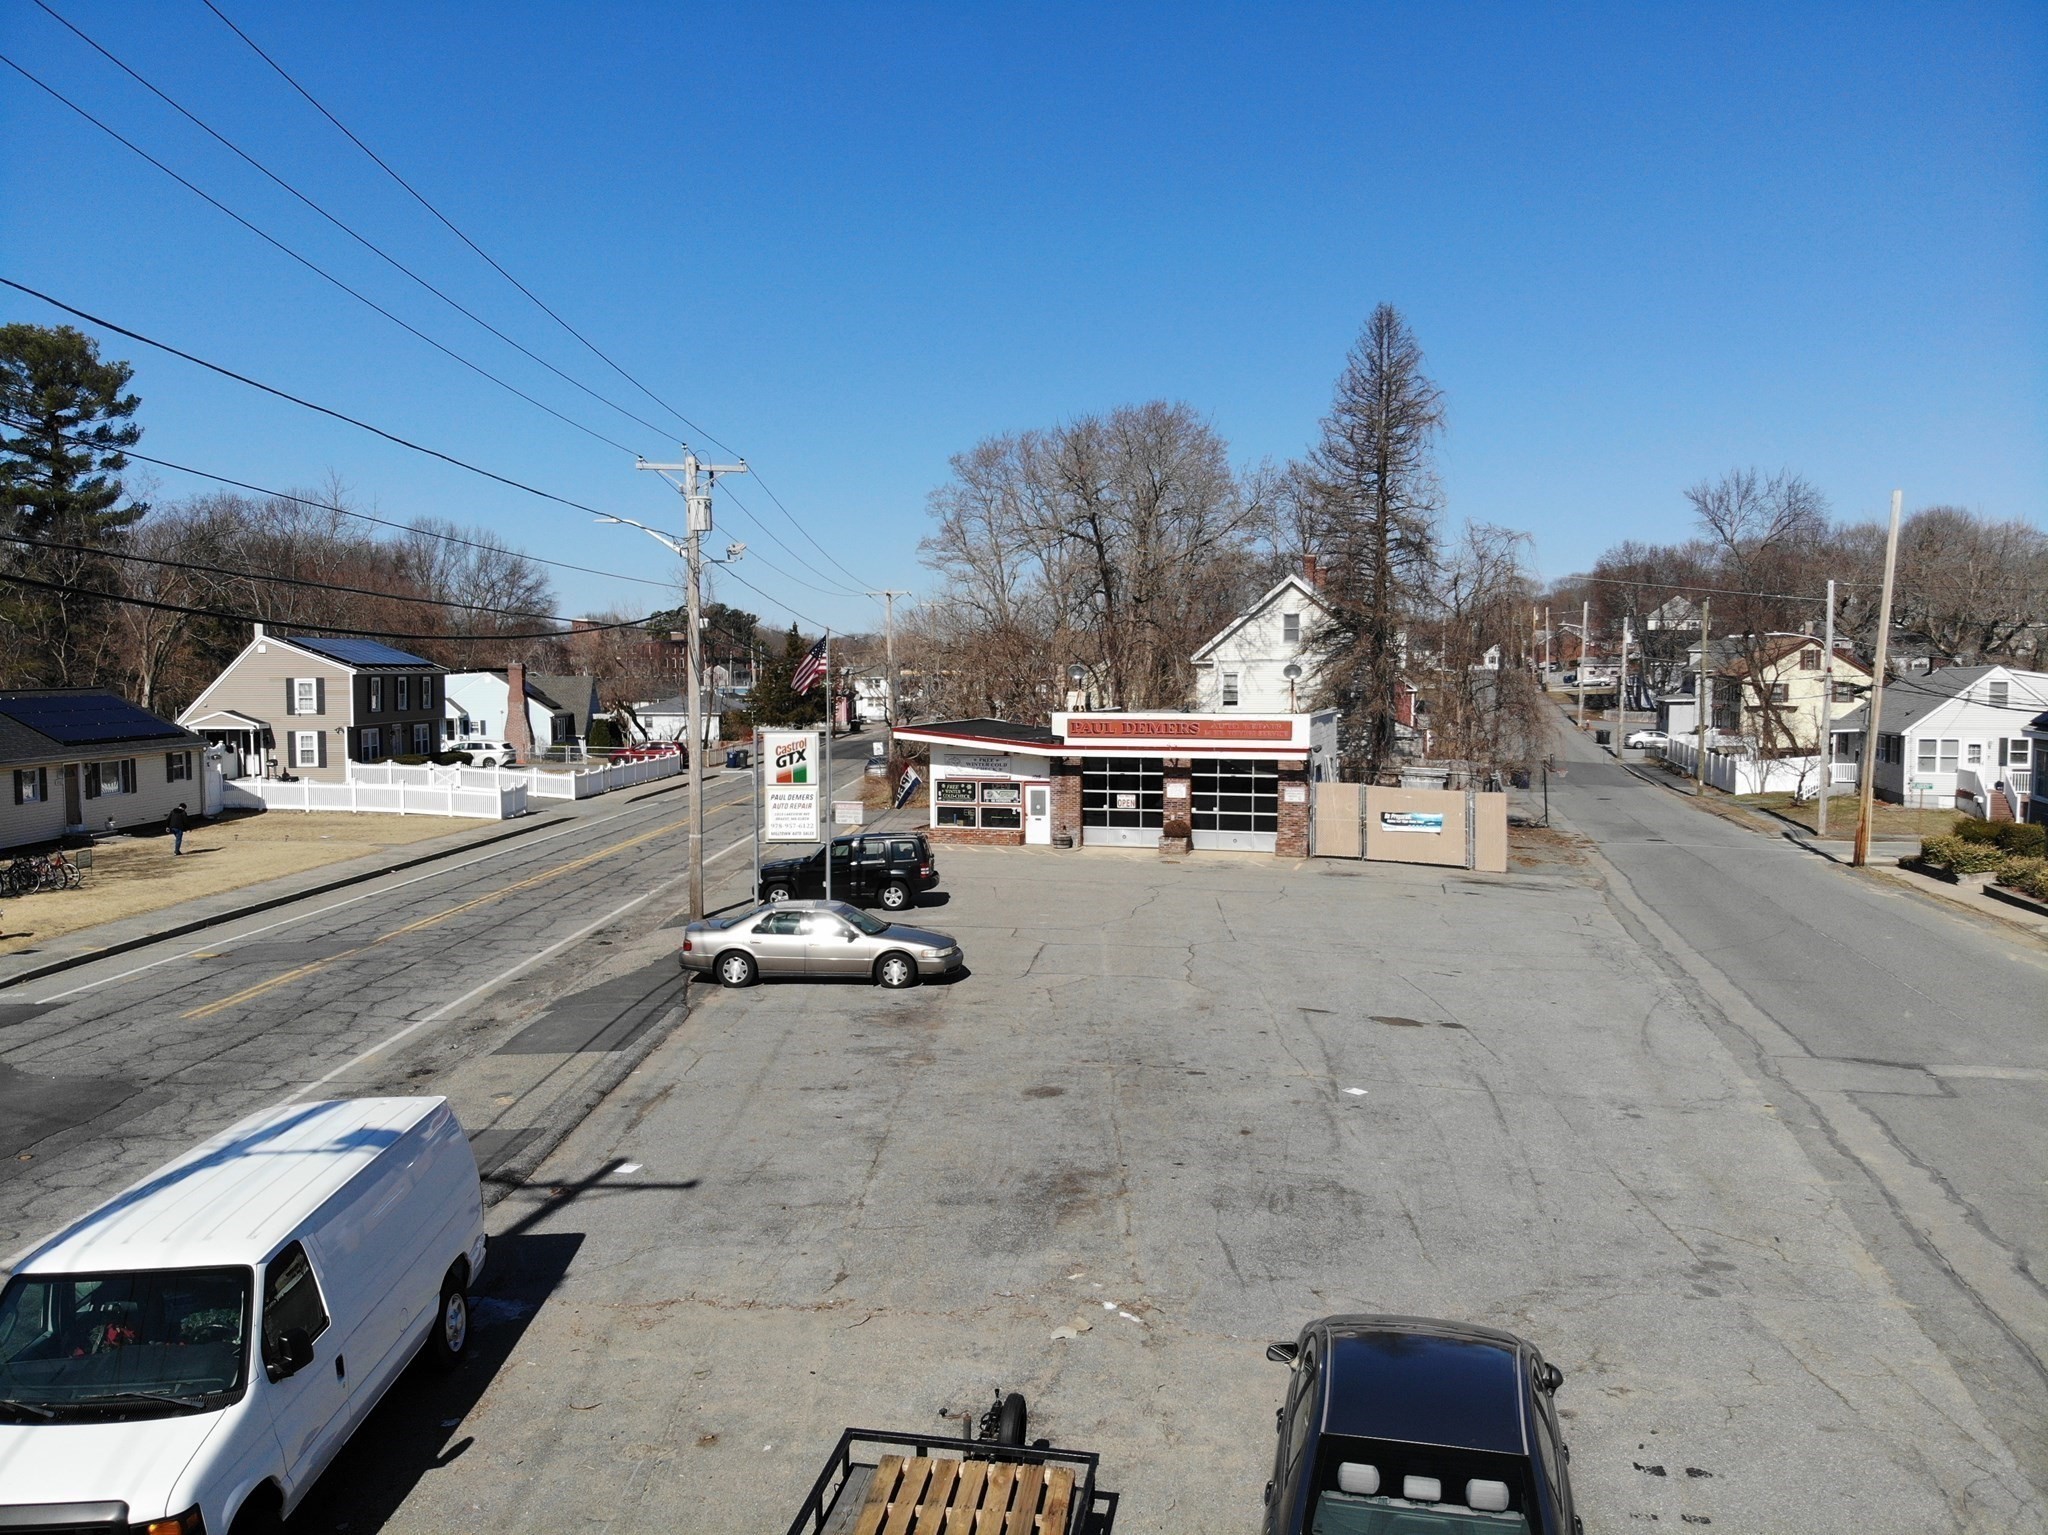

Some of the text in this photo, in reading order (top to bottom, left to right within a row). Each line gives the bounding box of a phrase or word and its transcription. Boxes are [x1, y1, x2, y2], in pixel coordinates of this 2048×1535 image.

[1071, 722, 1199, 736] PAUL DEMERS
[1210, 722, 1282, 730] AUTO REPAIR
[775, 737, 807, 756] Castrol
[776, 748, 807, 769] GTX
[770, 793, 815, 801] PAUL DEMERS
[772, 802, 813, 810] AUTO REPAIR
[1117, 799, 1136, 807] OPEN
